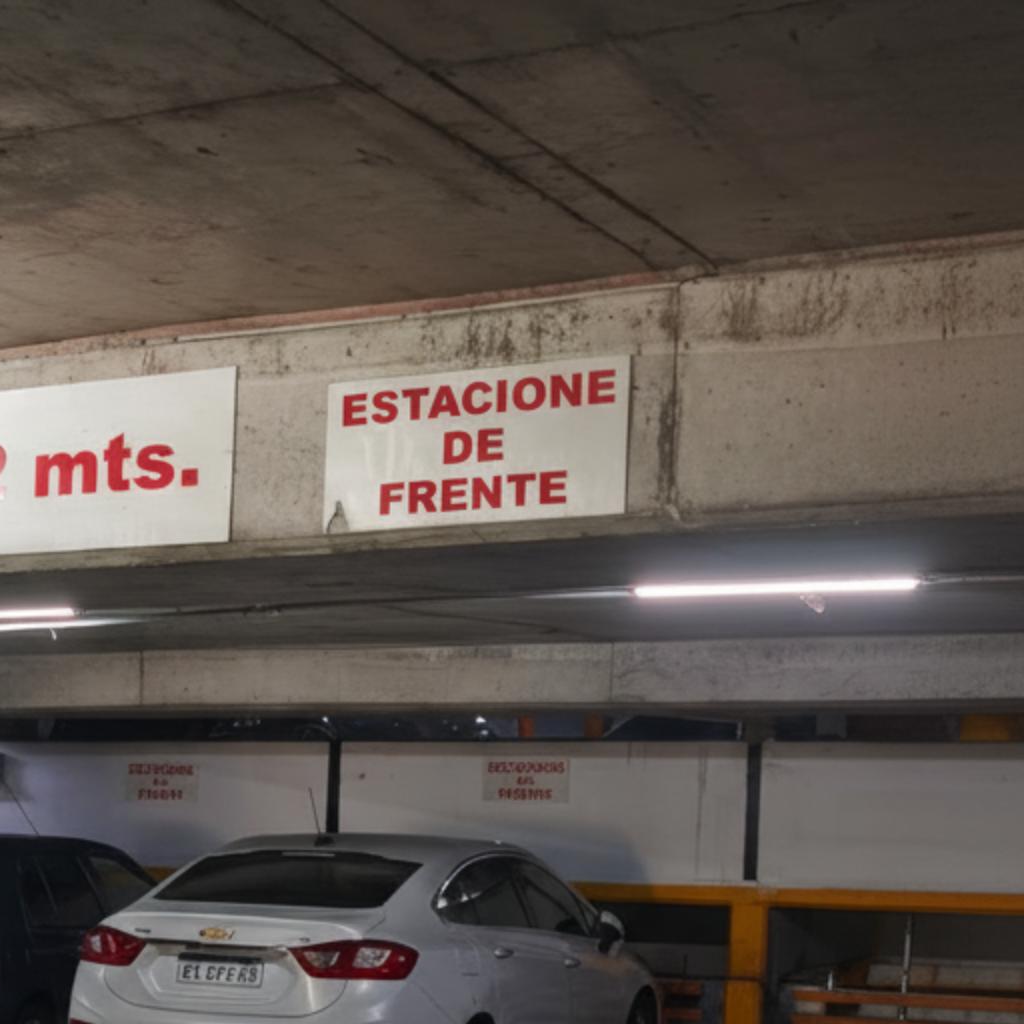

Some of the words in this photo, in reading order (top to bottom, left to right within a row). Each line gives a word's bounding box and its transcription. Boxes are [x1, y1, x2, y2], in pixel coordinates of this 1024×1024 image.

[341, 368, 617, 427] ESTACIONE
[33, 432, 200, 499] mts.
[442, 428, 505, 465] DE
[379, 470, 568, 515] FRENTE
